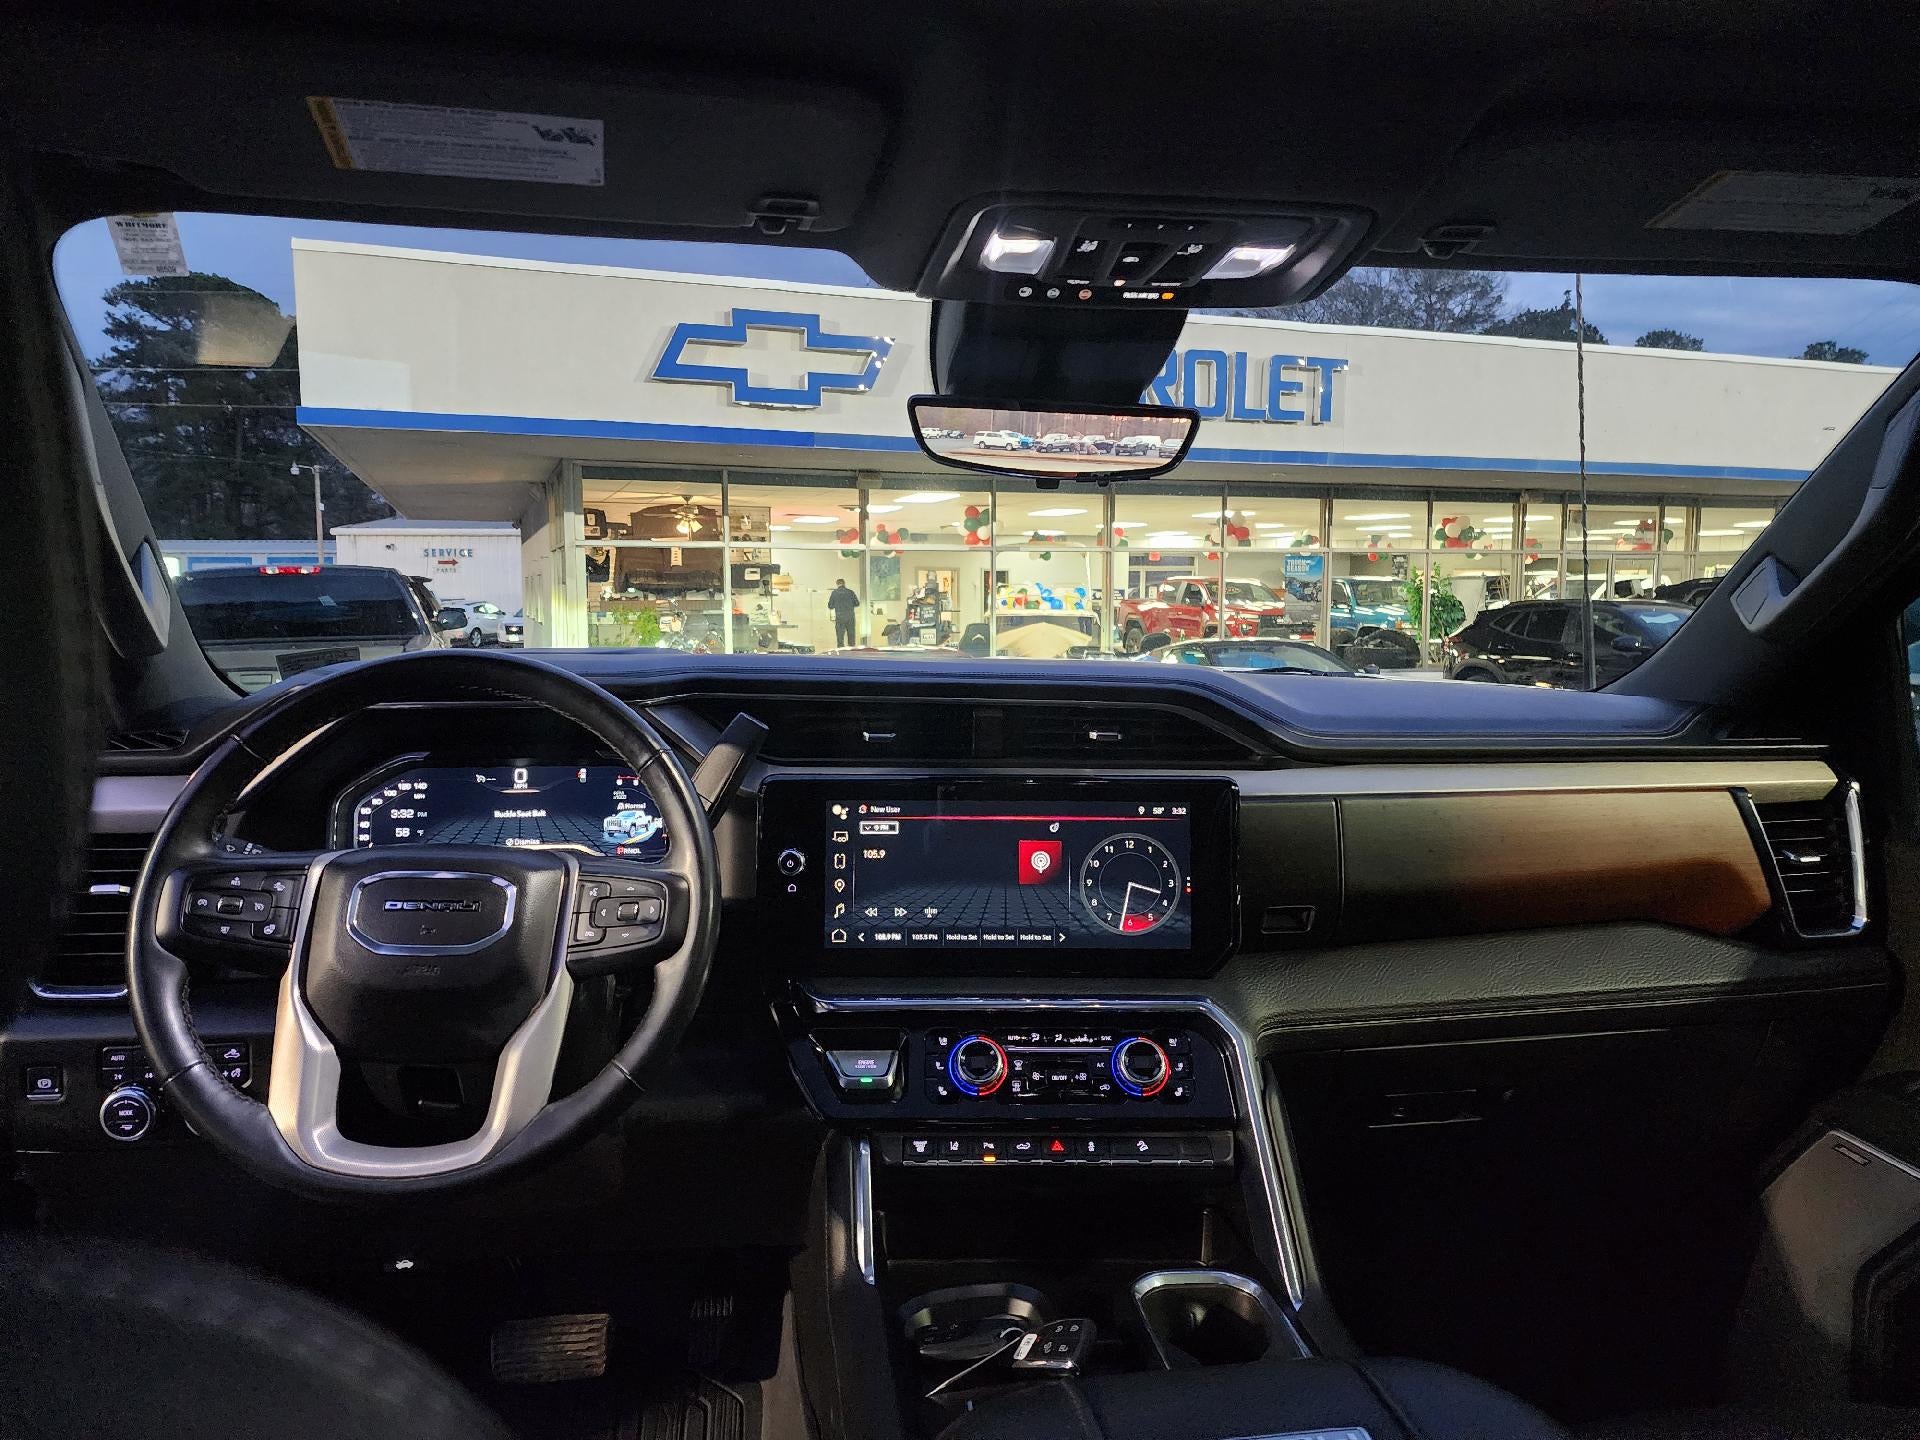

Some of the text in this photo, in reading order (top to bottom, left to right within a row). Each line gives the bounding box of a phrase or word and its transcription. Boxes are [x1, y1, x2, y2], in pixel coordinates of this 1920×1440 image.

[423, 548, 473, 558] SERVICE
[513, 782, 528, 790] MPH
[870, 804, 901, 813] New User
[1171, 807, 1187, 815] 3:32
[390, 808, 415, 819] 3:32
[493, 810, 516, 818] Buckle
[1124, 840, 1135, 849] 12
[862, 849, 886, 859] 105.9
[1104, 845, 1114, 854] 11
[1147, 845, 1153, 854] 1
[1089, 859, 1100, 868] 10
[1162, 860, 1168, 868] 2
[1086, 879, 1093, 887] 9
[1167, 879, 1175, 888] 3
[384, 901, 482, 912] DENALI
[1091, 899, 1098, 907] 8
[1162, 899, 1168, 907] 4
[1106, 912, 1113, 921] 7
[1147, 914, 1154, 922] 5
[1126, 918, 1133, 926] 6
